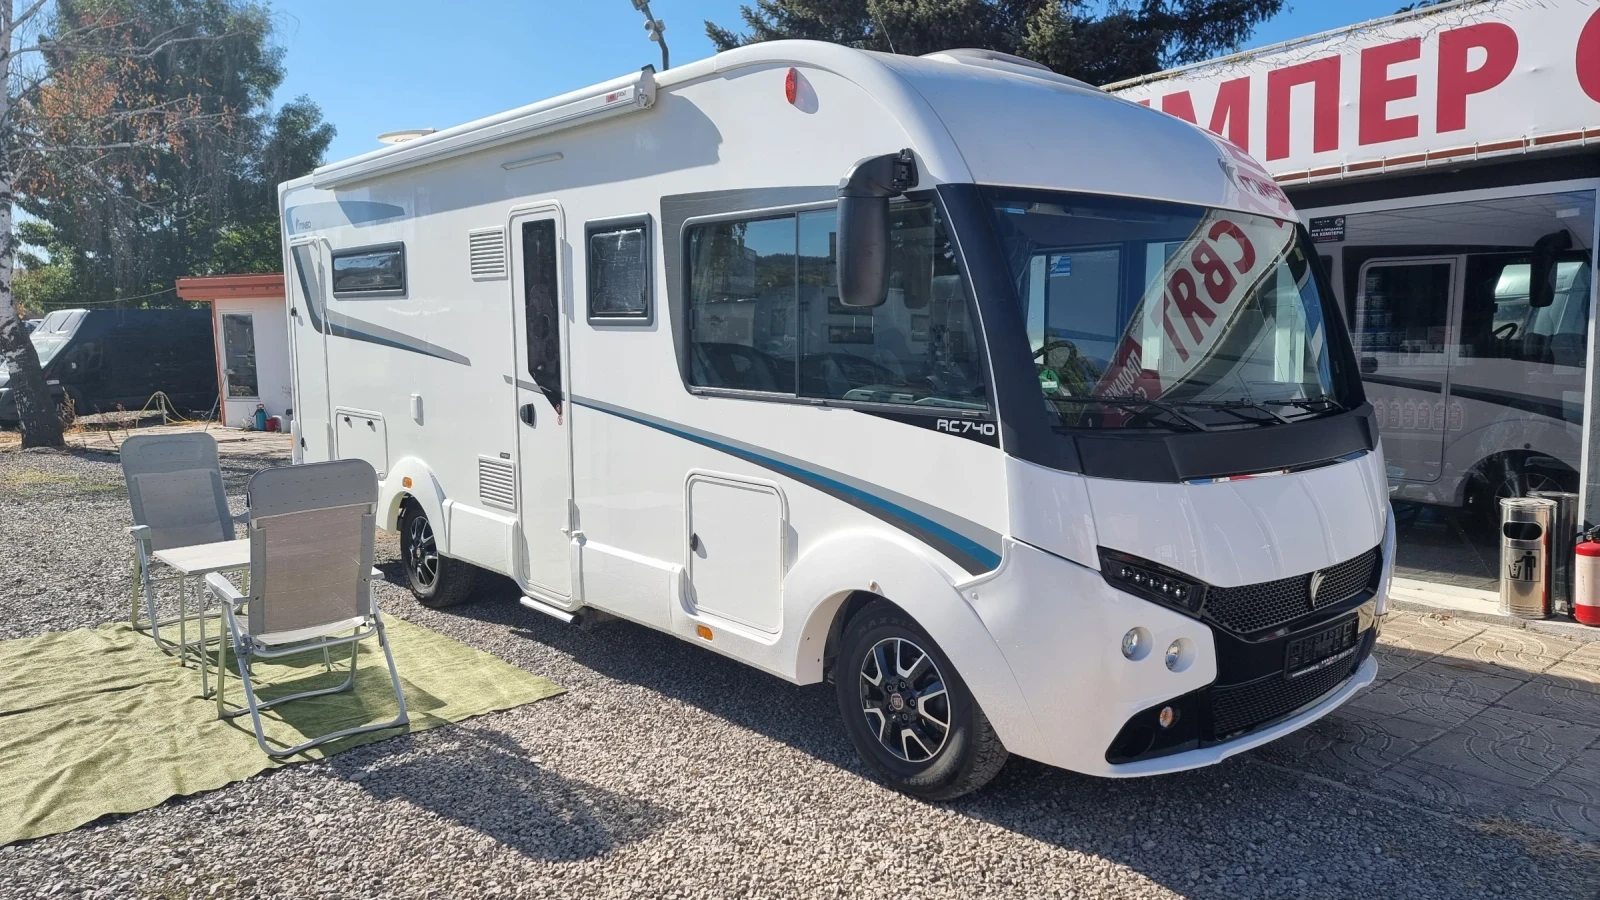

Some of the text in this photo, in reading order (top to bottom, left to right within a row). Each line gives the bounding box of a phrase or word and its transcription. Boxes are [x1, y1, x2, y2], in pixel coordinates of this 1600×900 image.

[1137, 22, 1519, 162] МПЕР
[936, 418, 996, 436] RC740
[858, 617, 918, 636] MAXXIS
